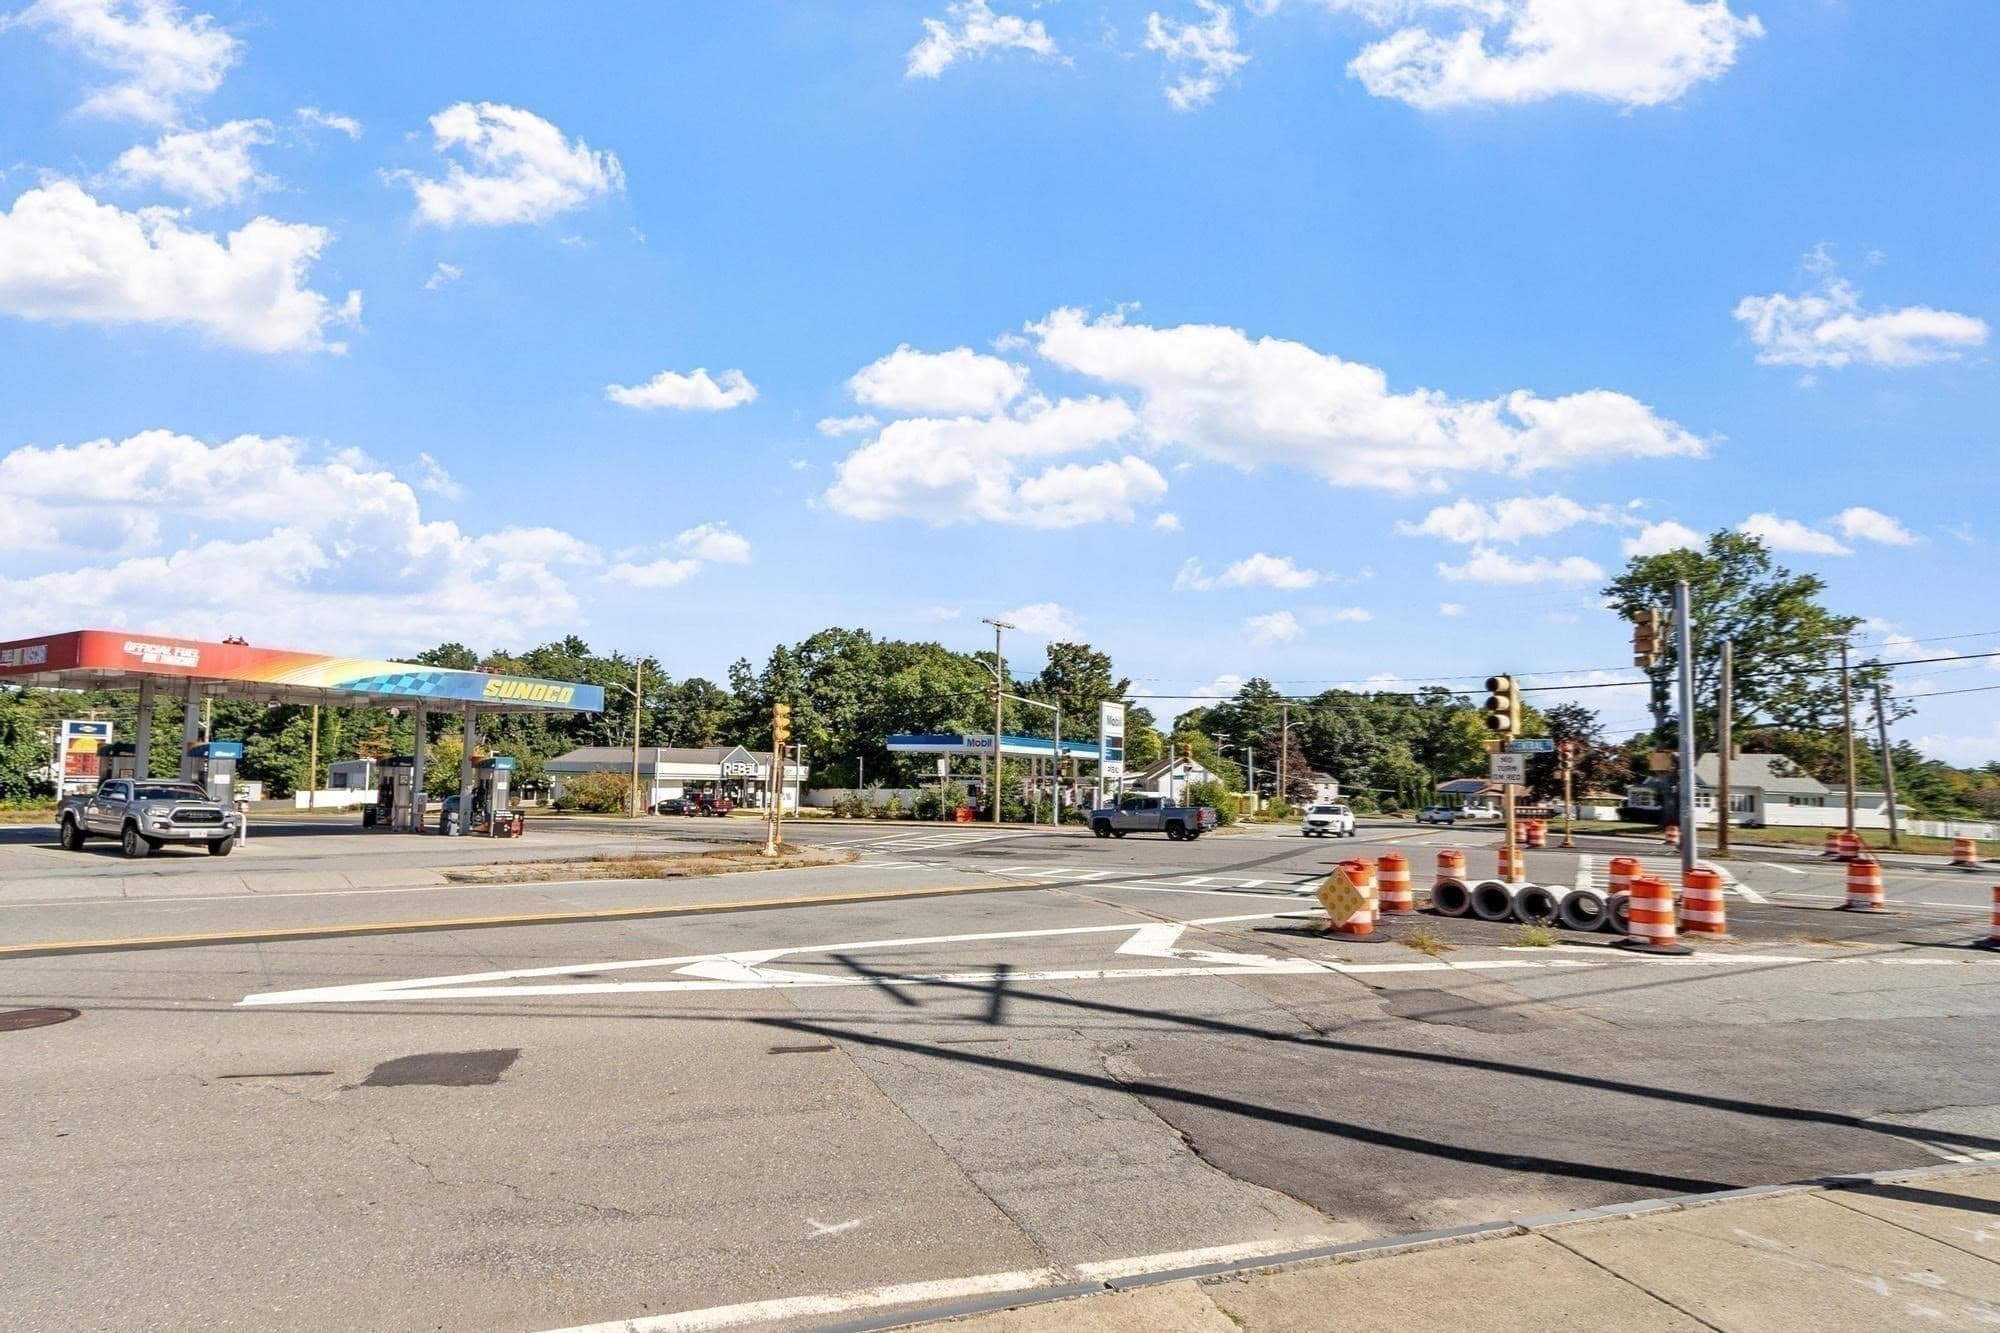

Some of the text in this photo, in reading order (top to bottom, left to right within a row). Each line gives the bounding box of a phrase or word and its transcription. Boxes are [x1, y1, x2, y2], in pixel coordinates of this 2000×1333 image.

[482, 679, 575, 703] SUNOCO
[966, 737, 992, 748] Mobil
[1500, 756, 1513, 764] NO
[723, 762, 758, 777] REBEL
